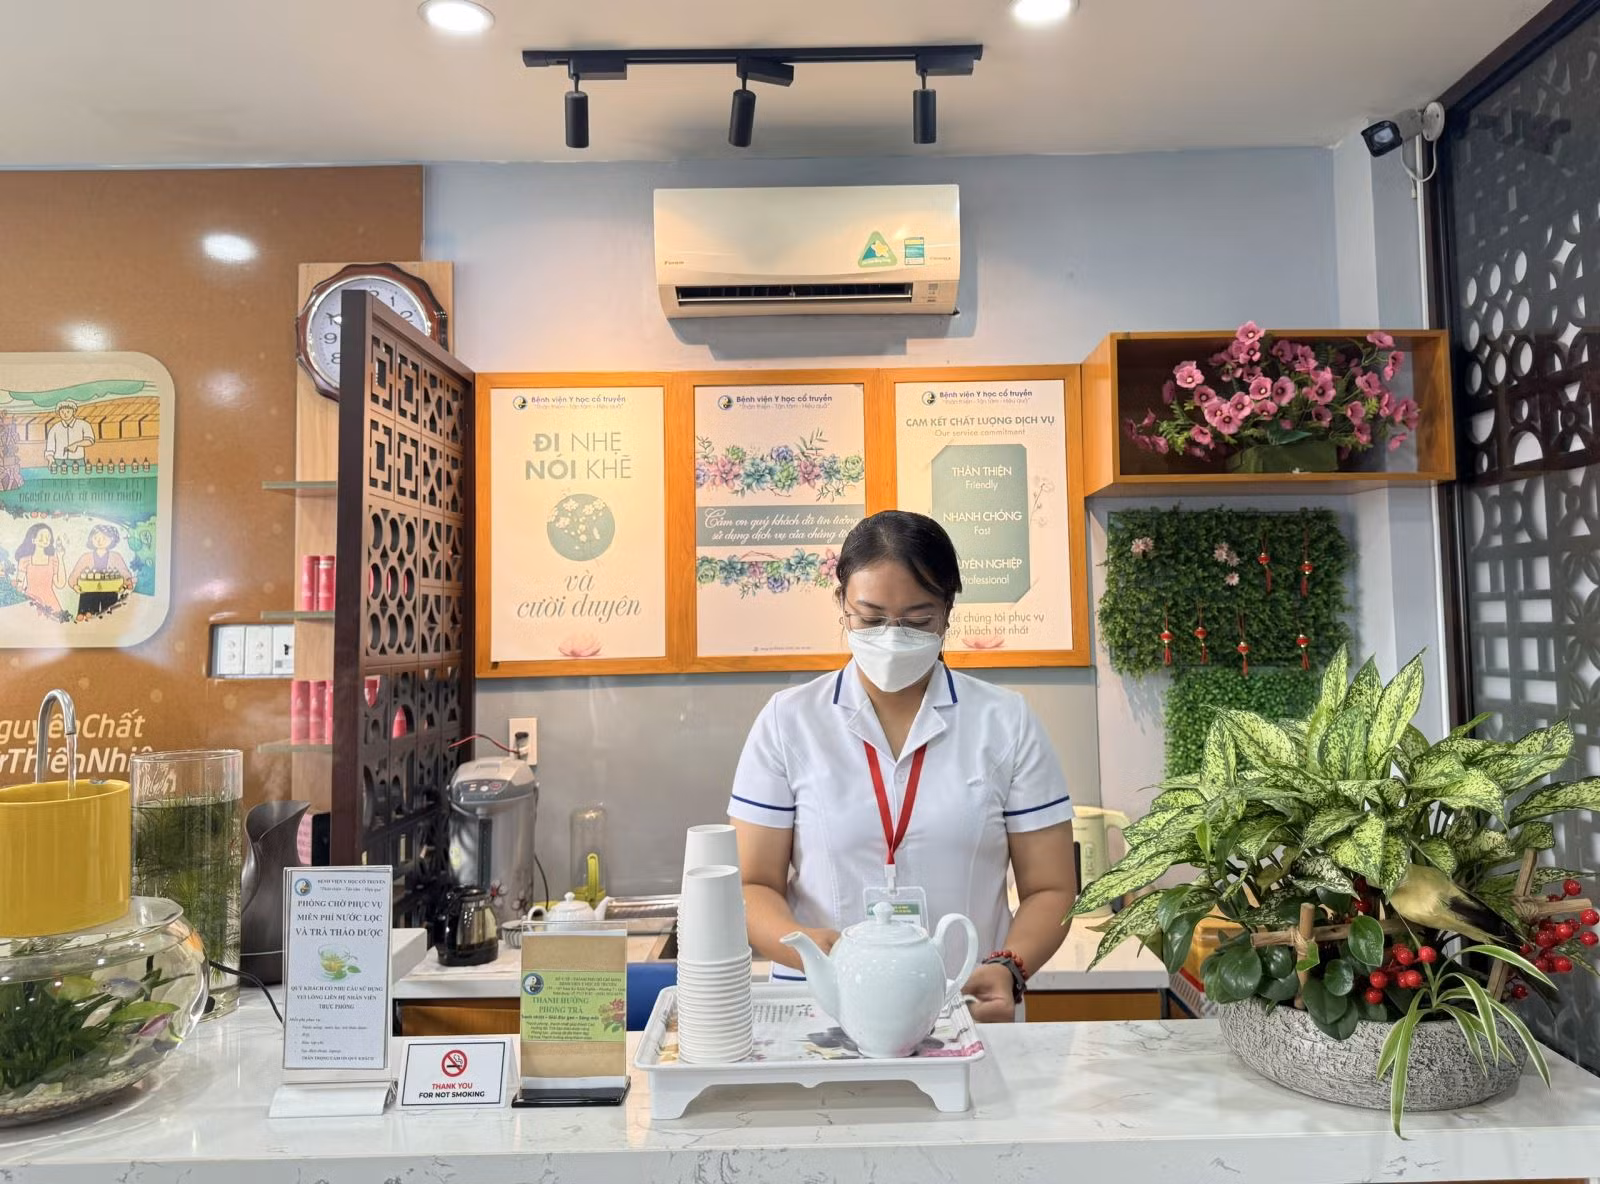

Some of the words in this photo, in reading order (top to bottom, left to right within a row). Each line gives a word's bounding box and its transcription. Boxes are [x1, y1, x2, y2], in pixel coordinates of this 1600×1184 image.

[390, 296, 394, 307] 1
[324, 333, 338, 344] 9
[531, 396, 550, 404] Bệnh
[552, 396, 567, 404] viện
[576, 396, 590, 404] học
[603, 394, 626, 403] truyền
[736, 396, 755, 404] Bệnh
[756, 396, 772, 404] viện
[798, 393, 808, 402] cổ
[809, 394, 833, 403] truyền
[1010, 388, 1033, 398] truyền
[906, 418, 928, 427] CAM
[930, 416, 948, 426] KẾT
[950, 415, 976, 426] CHẤT
[1015, 416, 1038, 426] DỊCH
[1040, 416, 1055, 426] VỤ
[533, 433, 560, 452] ĐI
[572, 432, 622, 455] NHẸ
[526, 453, 576, 480] NÓI
[587, 455, 631, 479] KHẼ
[966, 479, 998, 491] Friendly
[704, 508, 733, 528] Cảm
[750, 516, 769, 530] quý
[772, 514, 800, 526] khách
[801, 513, 814, 524] đã
[816, 515, 830, 524] tin
[943, 511, 981, 522] NHANH
[982, 509, 1022, 522] CHÓNG
[724, 528, 750, 544] dụng
[752, 527, 771, 542] dịch
[774, 532, 786, 542] vụ
[807, 527, 836, 544] chúng
[838, 527, 850, 538] tô
[974, 526, 991, 535] Fast
[958, 559, 984, 570] UYÊN
[986, 557, 1022, 570] NGHIỆP
[565, 569, 596, 592] và
[961, 574, 1010, 585] Professional
[516, 596, 566, 618] cười
[572, 593, 642, 624] duyên
[964, 612, 991, 624] chúng
[994, 611, 1006, 622] tôi
[1009, 610, 1031, 623] phục
[1033, 613, 1045, 622] vụ
[964, 625, 991, 636] khách
[994, 625, 1006, 635] tốt
[1008, 624, 1029, 635] nhất
[298, 899, 326, 907] PHÒNG
[328, 899, 346, 907] CHỜ
[348, 901, 370, 909] PHỤC
[336, 913, 362, 921] NƯỚC
[364, 914, 382, 923] LỌC
[296, 926, 307, 936] VÀ
[310, 926, 327, 936] TRÀ
[330, 927, 355, 936] THẢO
[357, 928, 383, 938] DƯỢC
